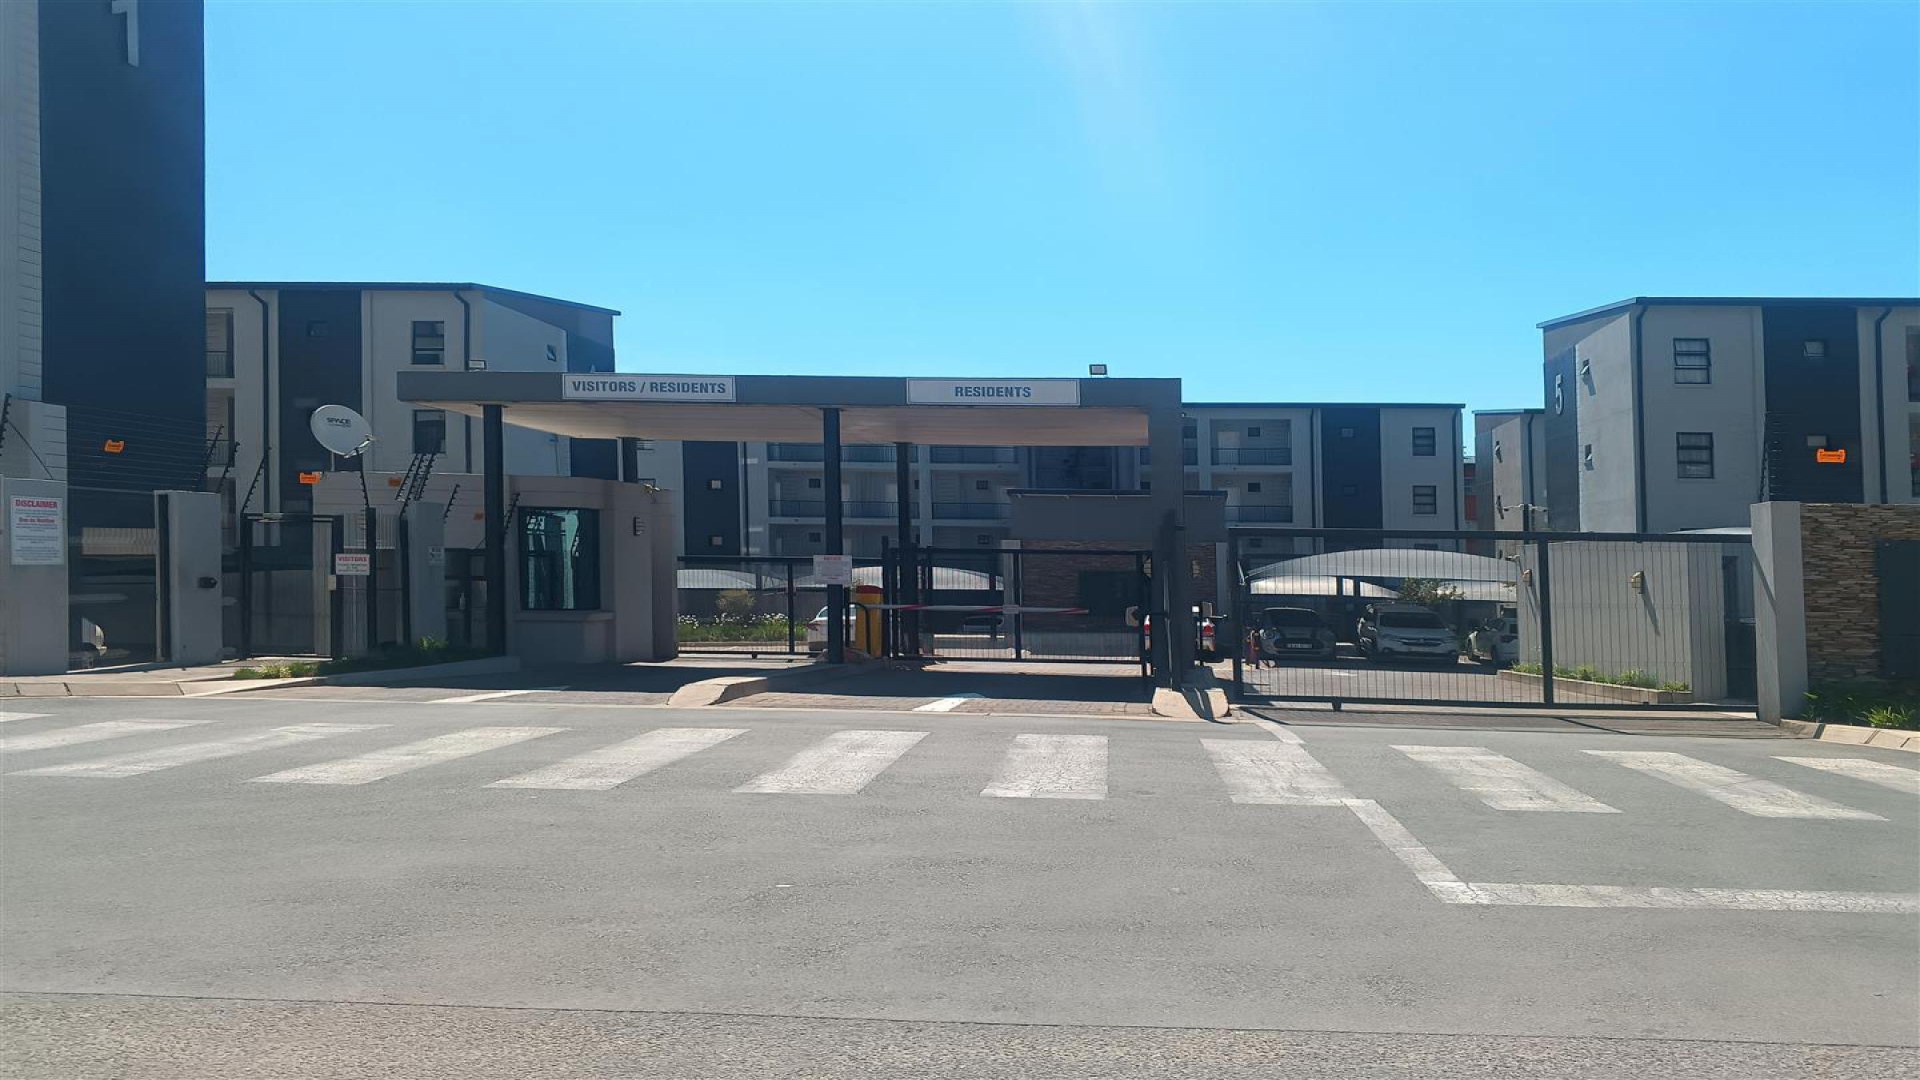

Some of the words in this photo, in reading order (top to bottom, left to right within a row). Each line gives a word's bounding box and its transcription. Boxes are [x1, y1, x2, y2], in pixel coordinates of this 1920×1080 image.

[572, 380, 636, 393] VISITORS
[640, 381, 646, 394] /
[650, 381, 726, 394] RESIDENTS
[955, 386, 1032, 398] RESIDENTS
[1555, 374, 1563, 415] 5
[15, 499, 58, 509] DISCLAIMER
